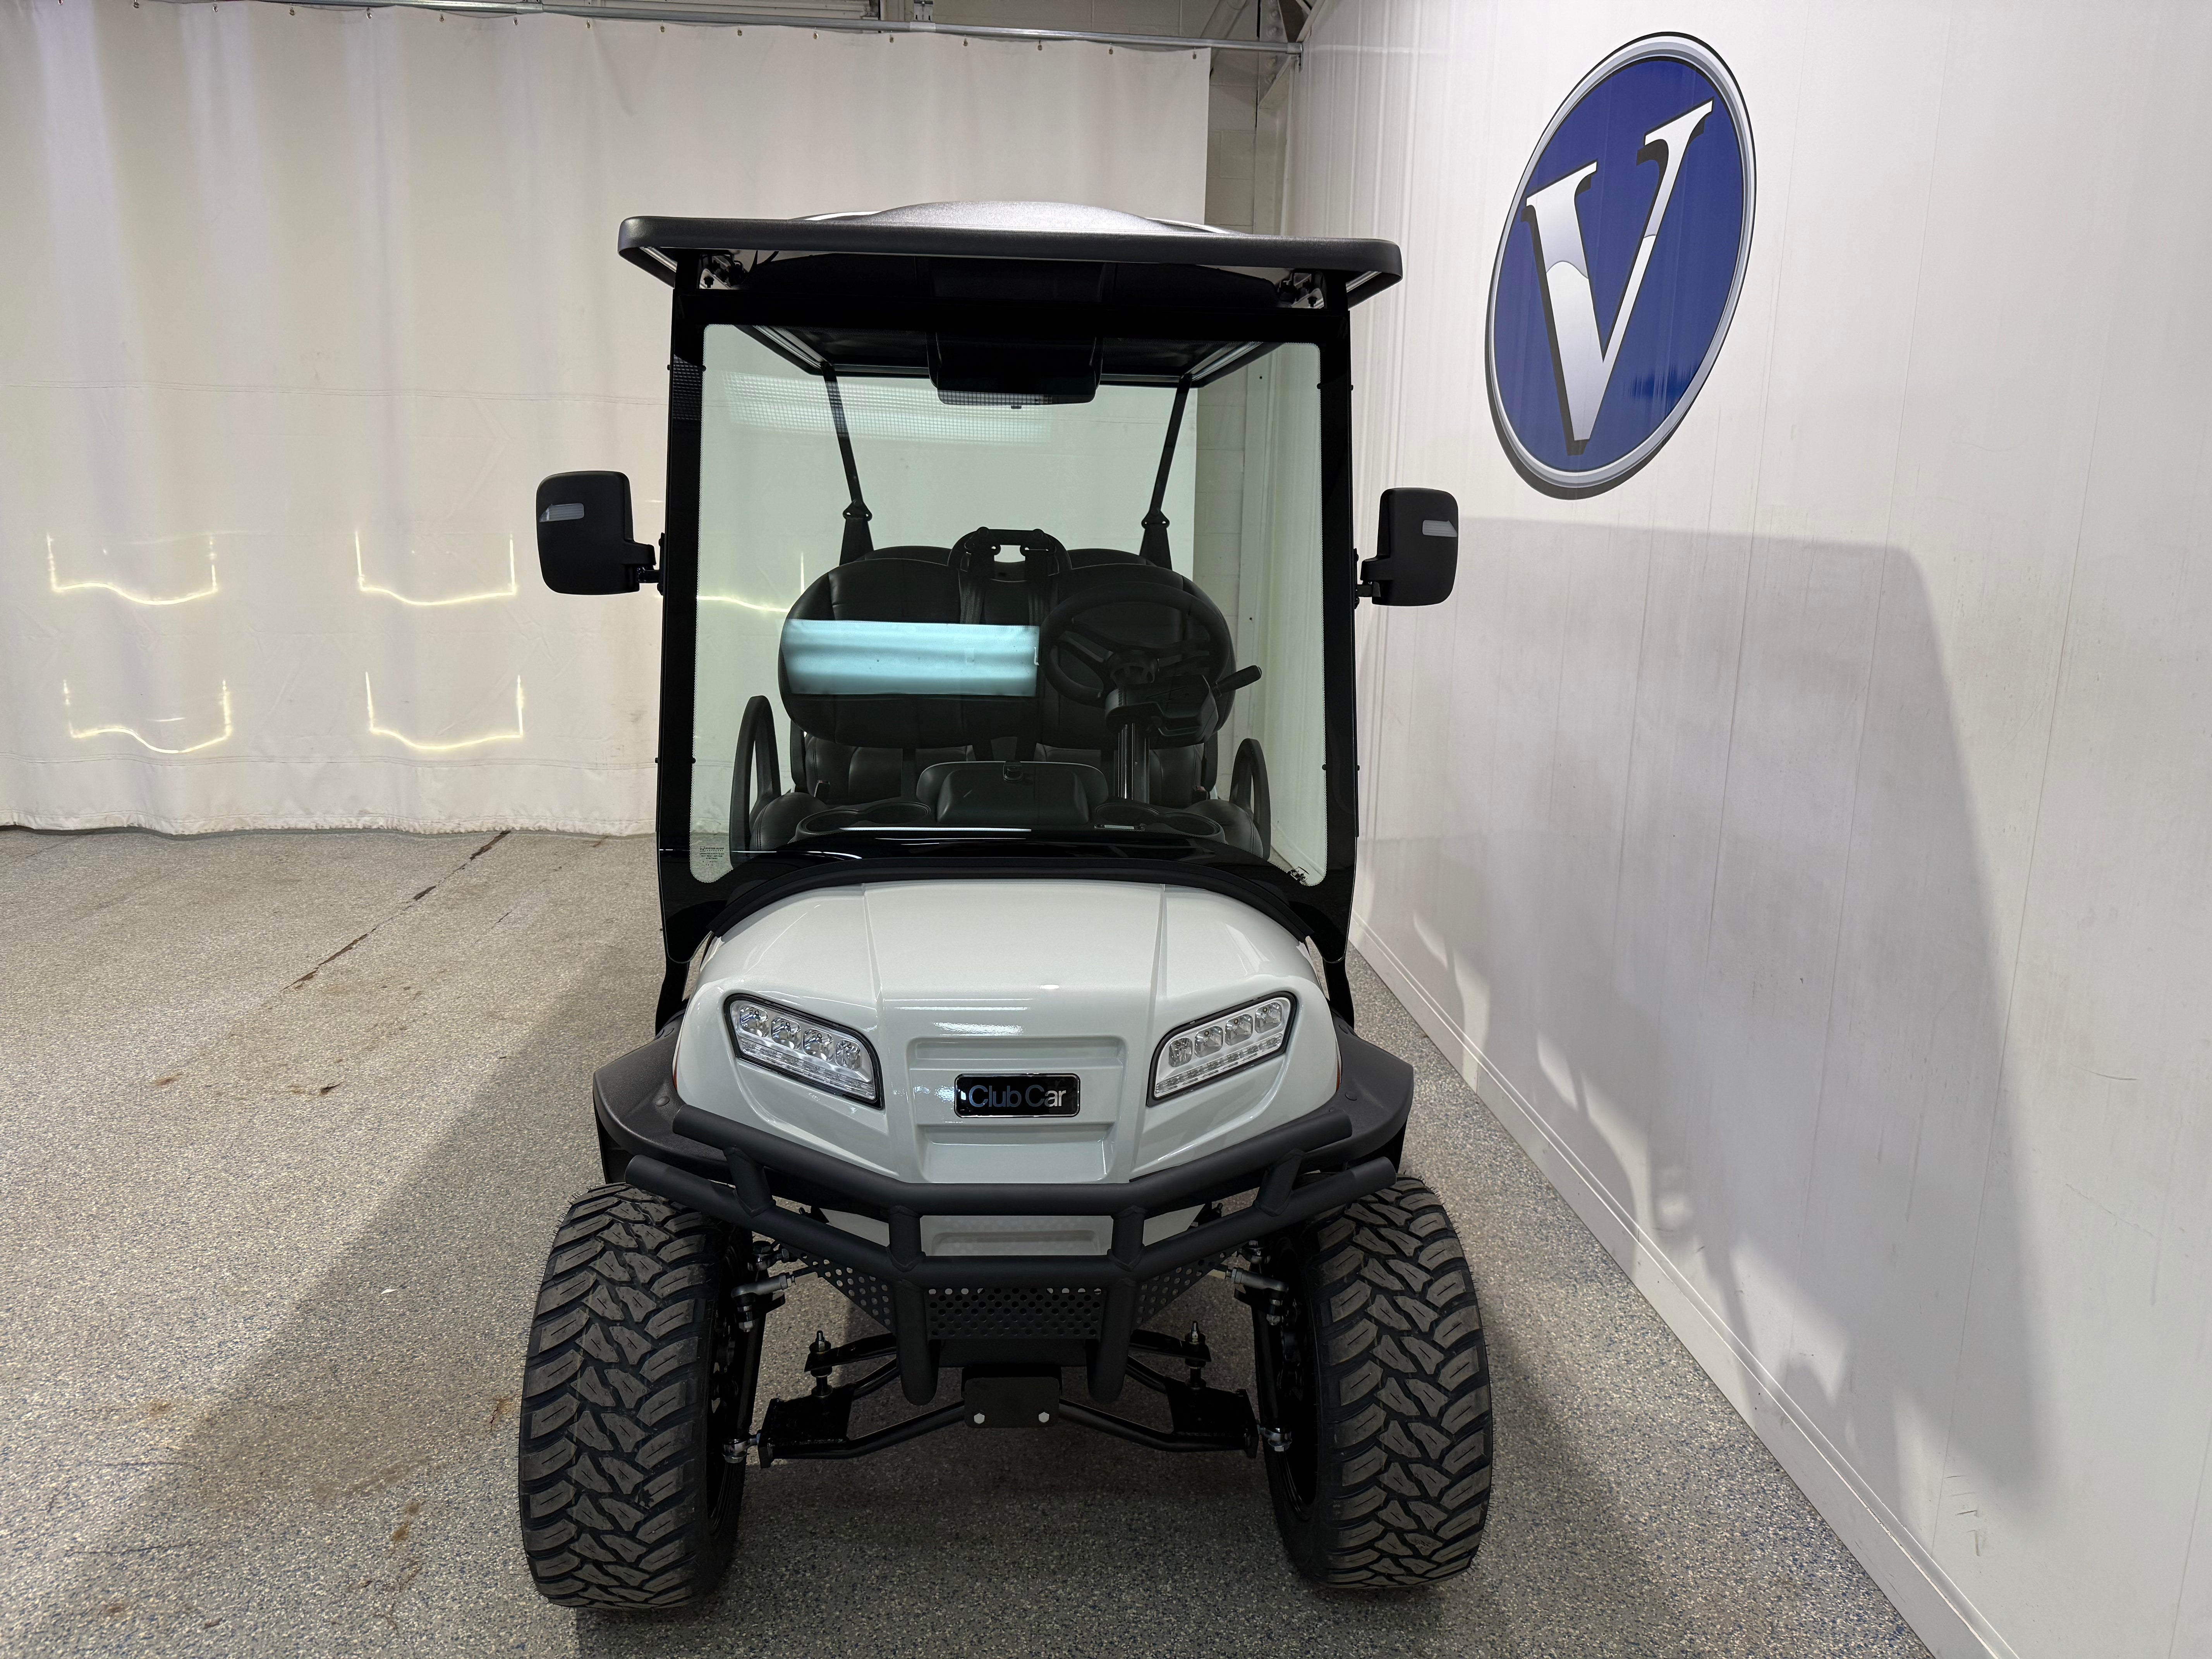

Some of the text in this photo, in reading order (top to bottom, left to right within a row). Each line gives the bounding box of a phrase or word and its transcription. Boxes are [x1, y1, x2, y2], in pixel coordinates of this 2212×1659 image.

[1523, 99, 1713, 442] V
[969, 1084, 1066, 1108] Club Car
